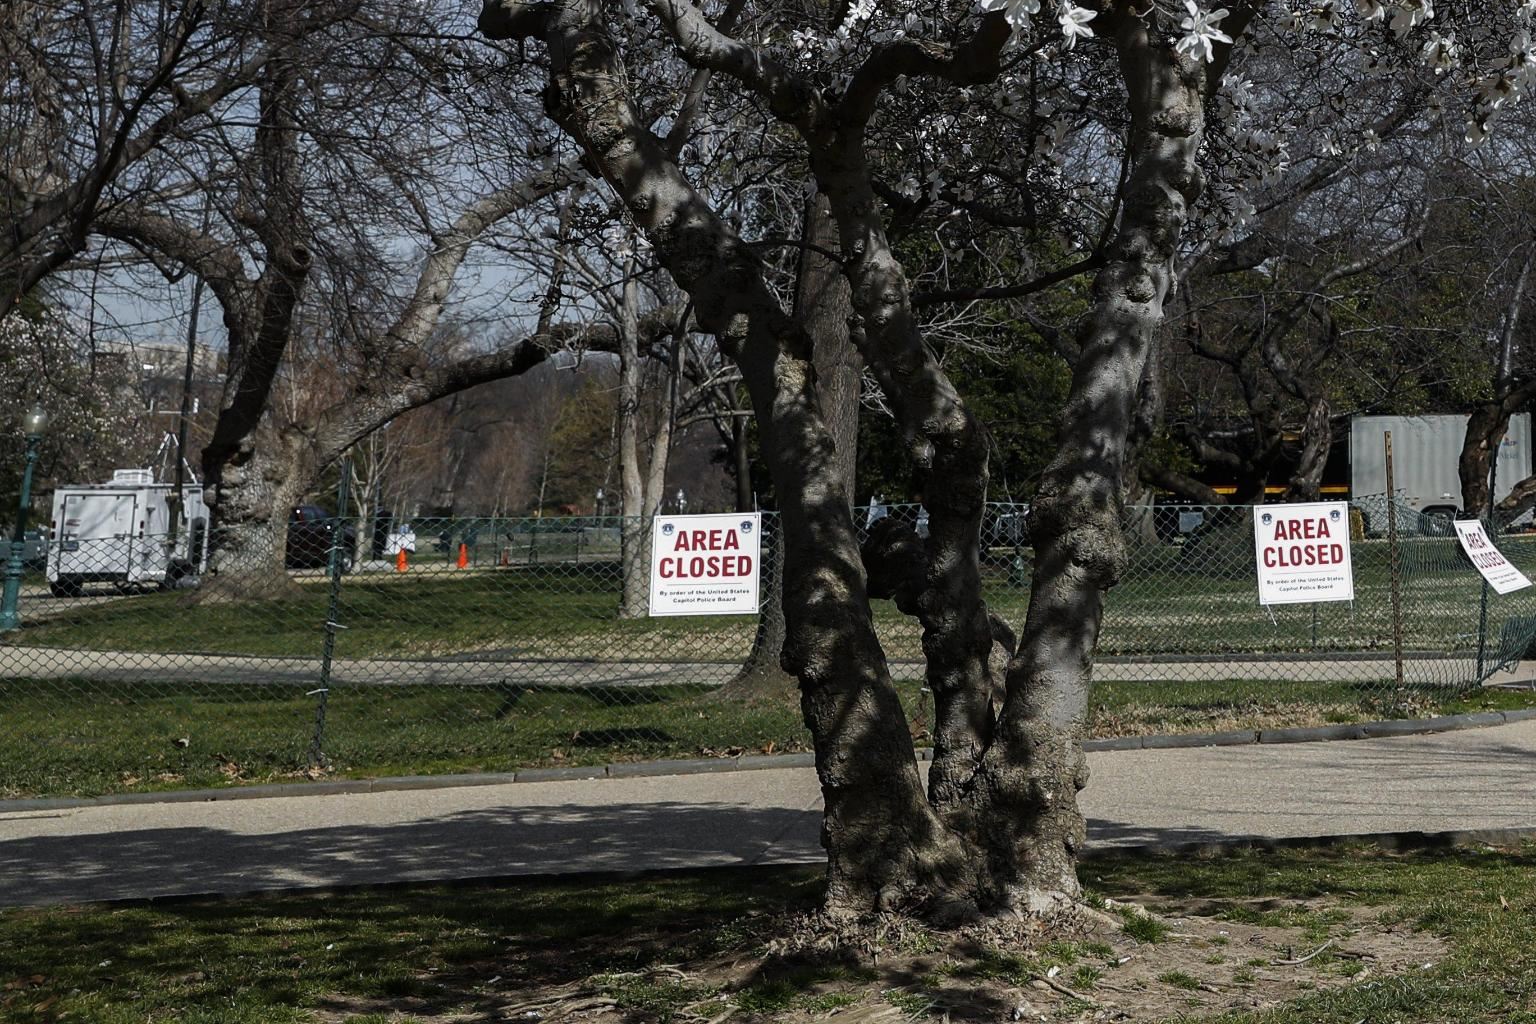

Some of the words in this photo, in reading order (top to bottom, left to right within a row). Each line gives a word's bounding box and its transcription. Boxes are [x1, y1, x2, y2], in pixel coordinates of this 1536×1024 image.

[673, 529, 740, 552] AREA
[1273, 518, 1331, 541] AREA
[1465, 532, 1488, 550] AREA
[659, 555, 753, 579] CLOSED
[1263, 543, 1344, 568] CLOSED
[1472, 551, 1506, 569] CLOSED
